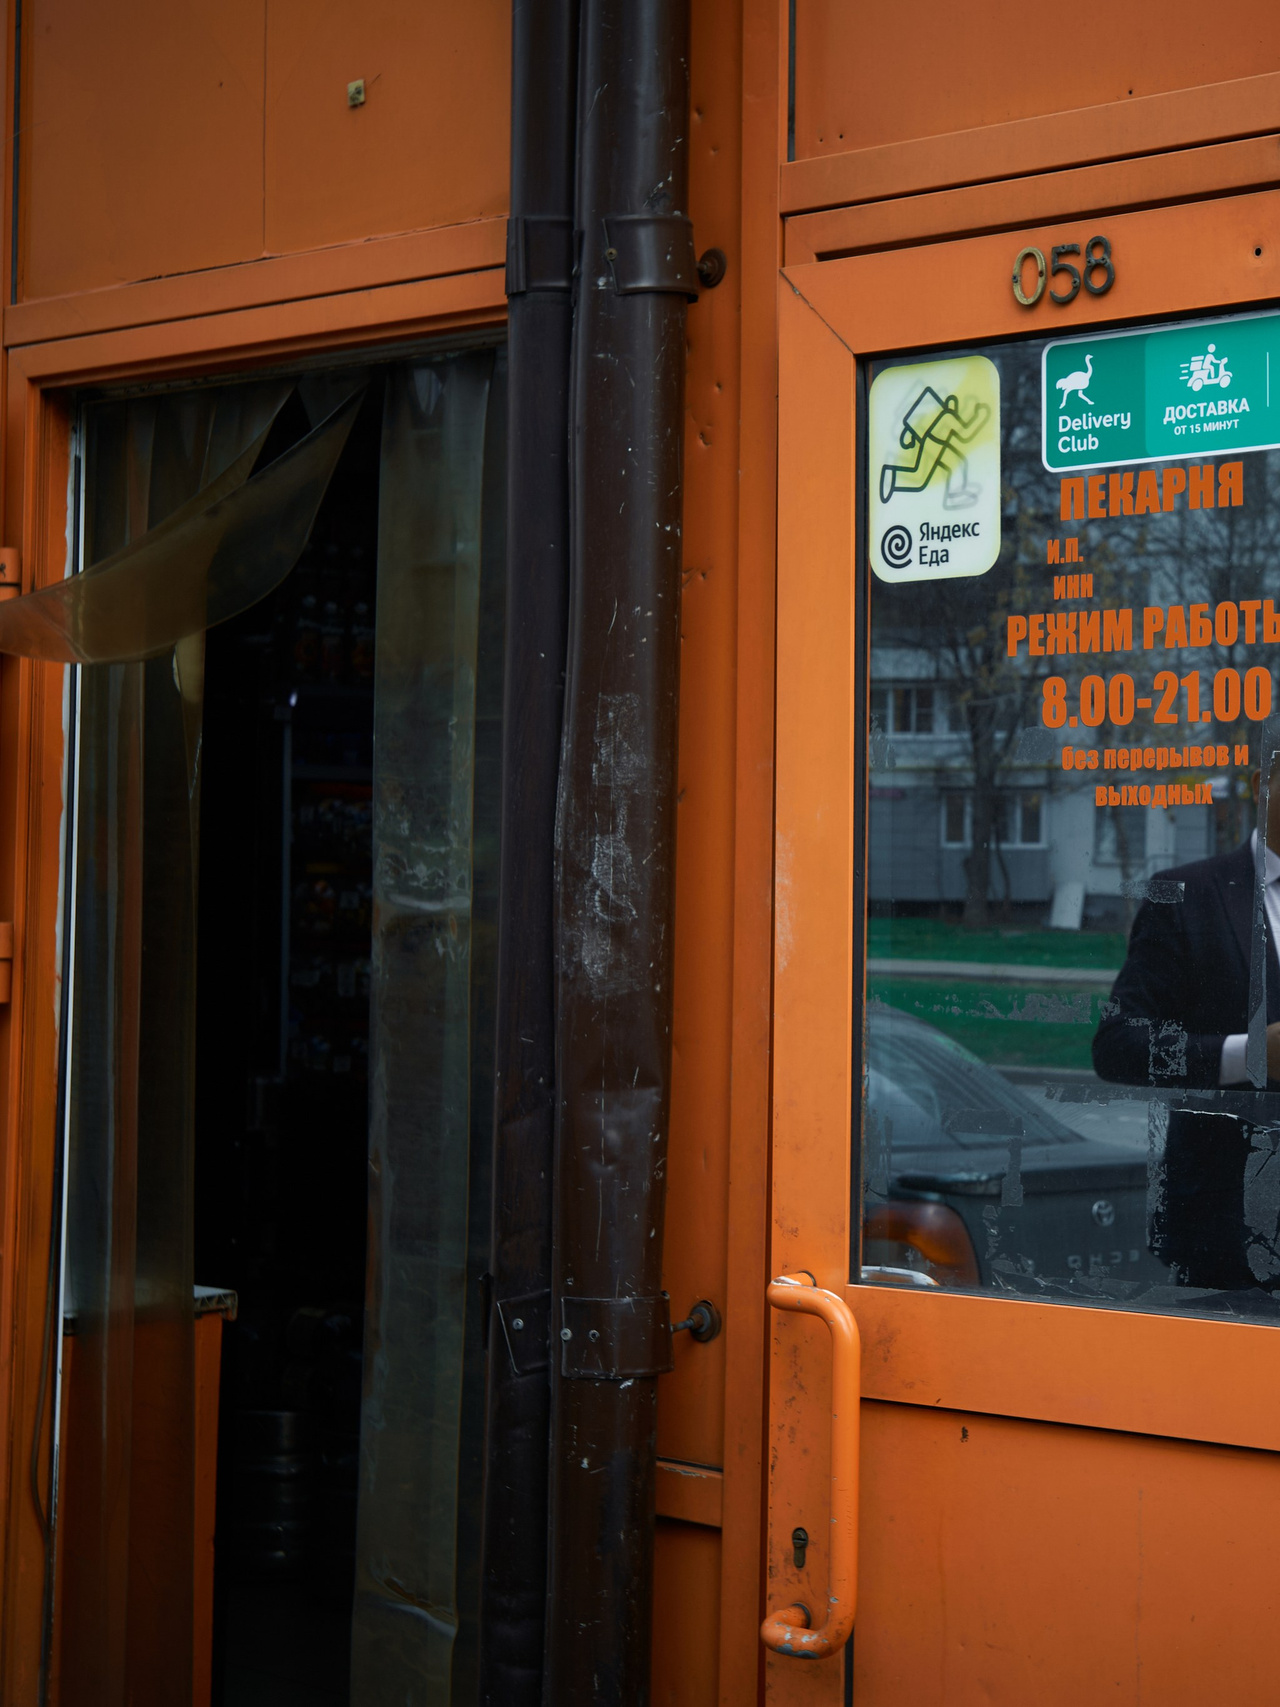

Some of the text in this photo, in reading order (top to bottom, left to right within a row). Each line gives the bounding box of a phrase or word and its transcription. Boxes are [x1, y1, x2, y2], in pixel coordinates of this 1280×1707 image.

[1012, 235, 1115, 305] 058
[1058, 412, 1131, 433] Delivery
[1163, 397, 1250, 425] ДОСТАВКА
[1174, 419, 1240, 436] ОТ 15 МИНУТ
[1058, 434, 1099, 453] Club
[1059, 461, 1244, 521] ПЕКАРНЯ
[919, 522, 980, 542] Яндекс
[919, 546, 949, 567] Еда
[1047, 538, 1084, 564] И.П.
[1053, 574, 1093, 600] ИНН
[1007, 608, 1133, 657] РЕЖИМ
[1042, 666, 1272, 728] 8.00-21.00
[1062, 745, 1249, 771] без перерывов и
[1095, 783, 1214, 809] выходных
